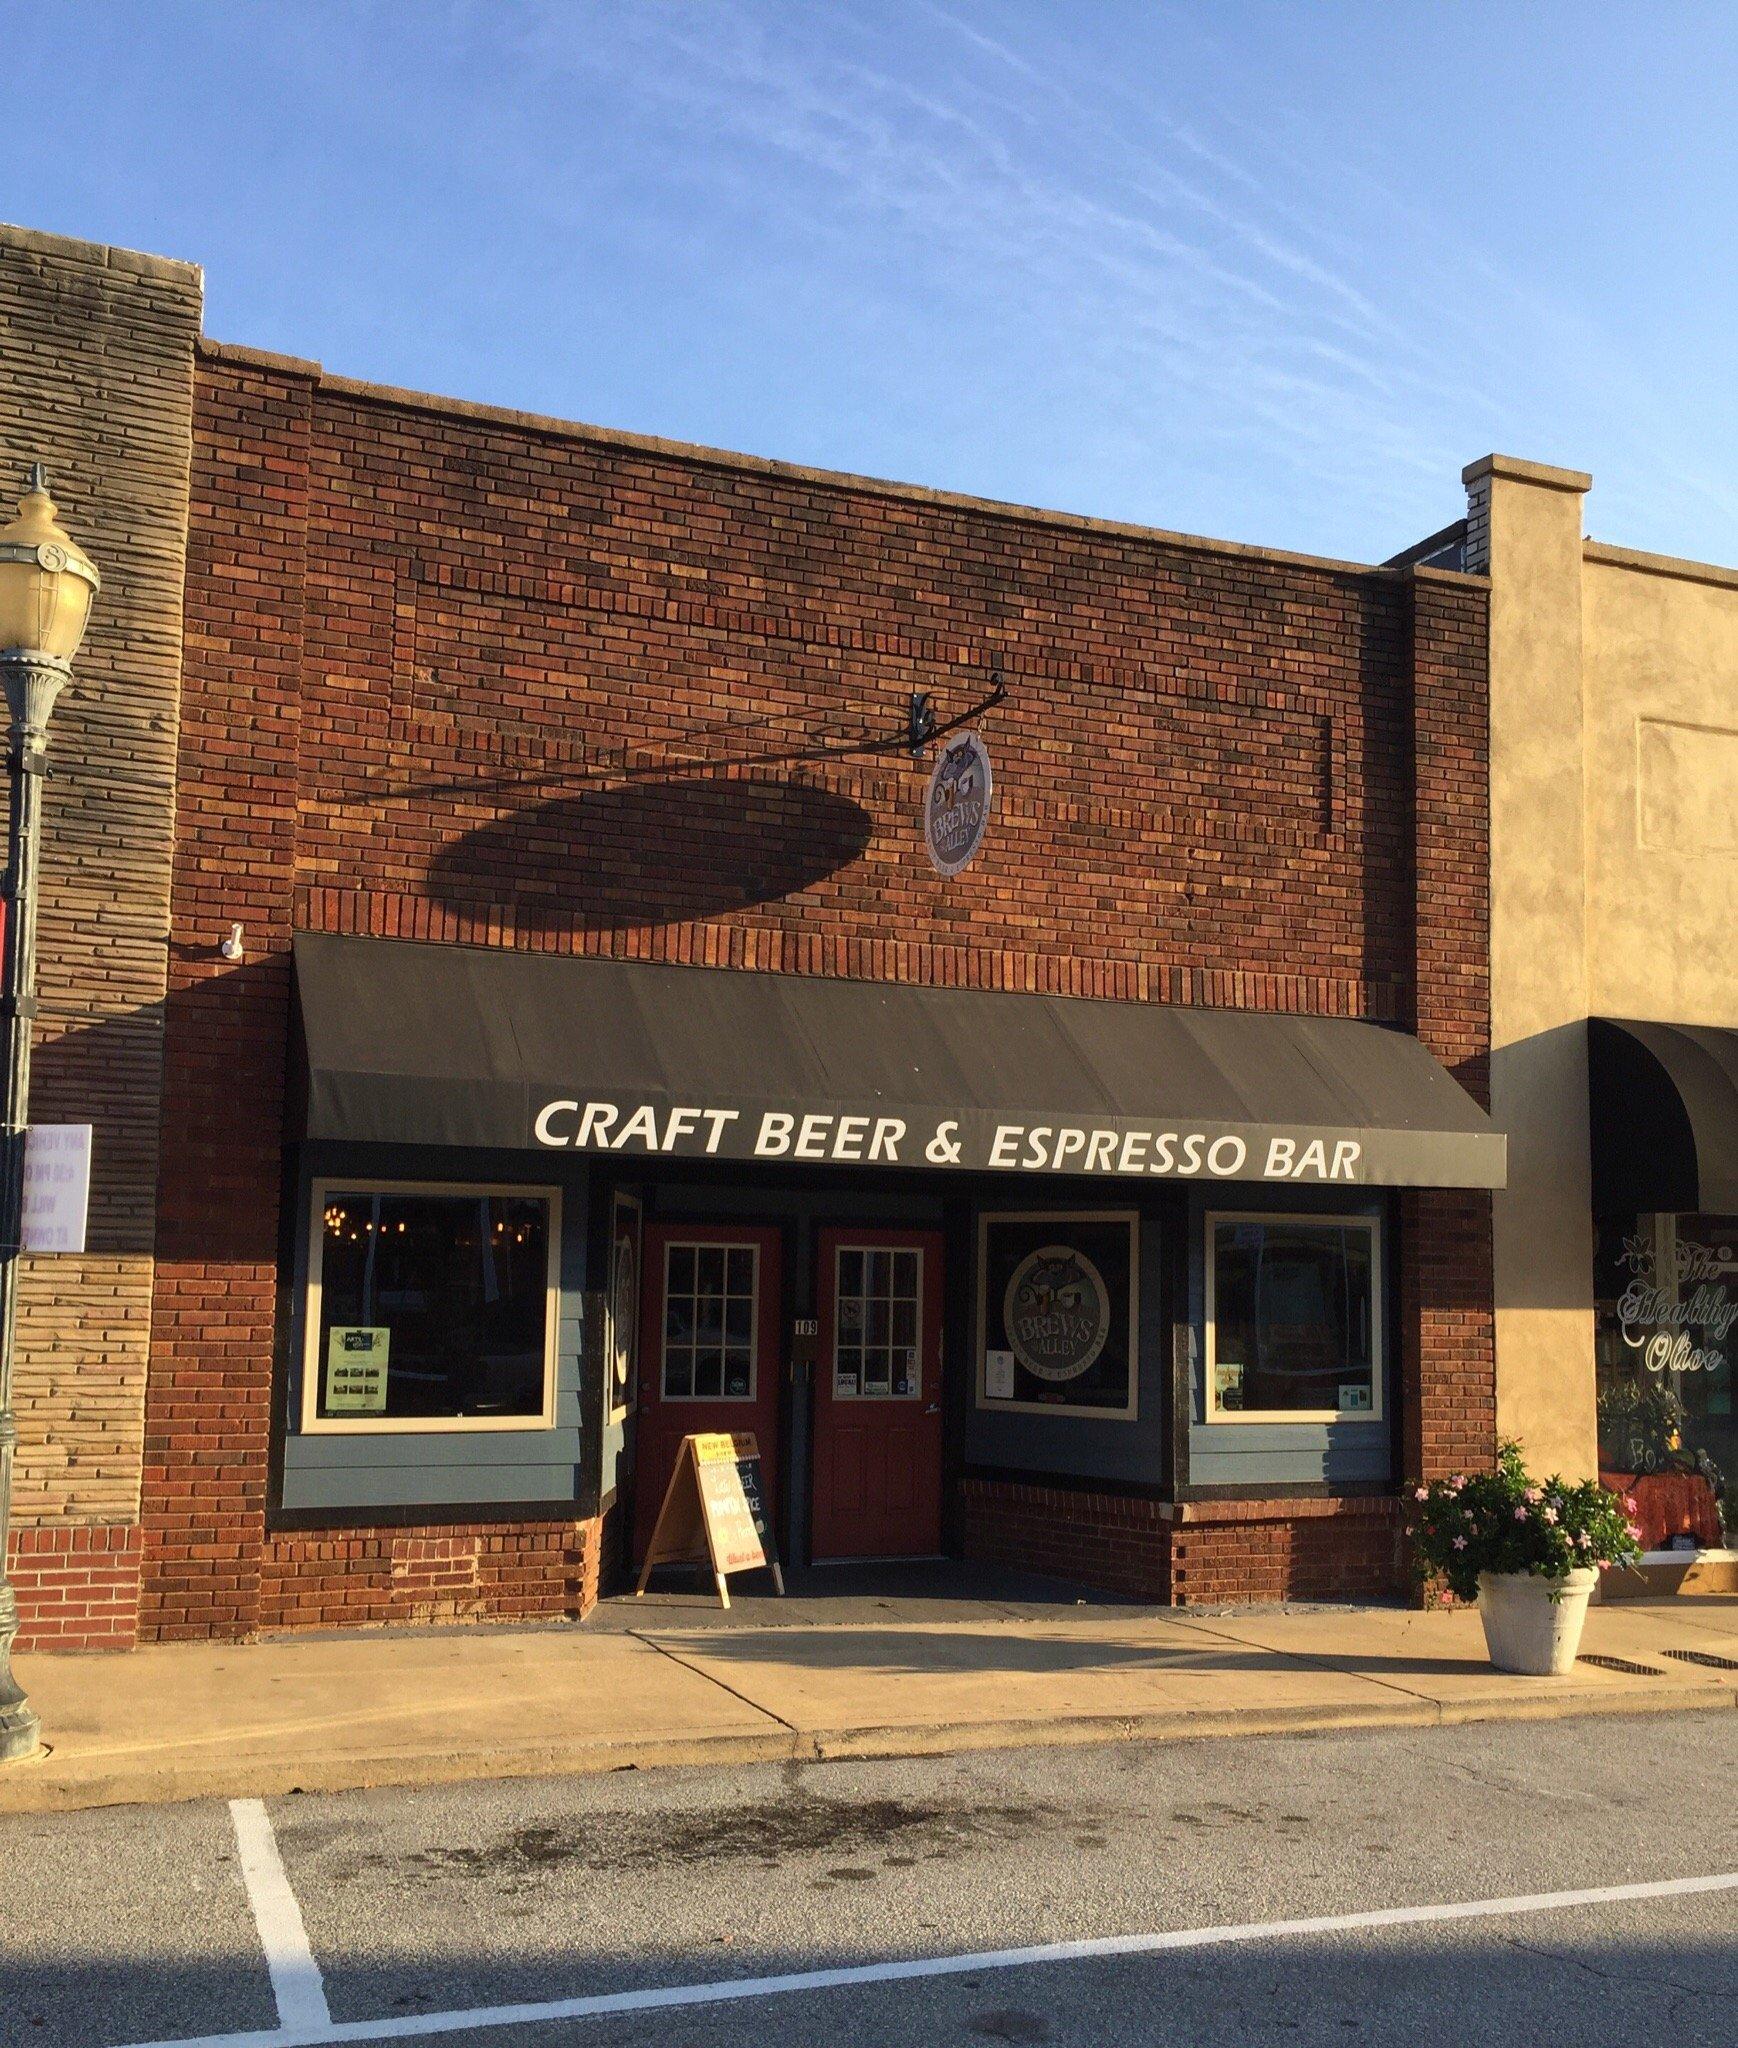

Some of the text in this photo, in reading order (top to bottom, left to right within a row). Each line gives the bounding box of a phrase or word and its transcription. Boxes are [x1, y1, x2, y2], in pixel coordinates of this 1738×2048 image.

[932, 801, 981, 845] BREWS
[534, 1100, 1361, 1179] CRAFT BEER & ESPRESSO BAR
[1675, 1239, 1721, 1282] The
[796, 1320, 817, 1335] 109
[1018, 1313, 1093, 1342] BREWS
[1617, 1279, 1738, 1342] Healthy
[1645, 1329, 1723, 1372] Olive
[701, 1441, 719, 1450] NEW
